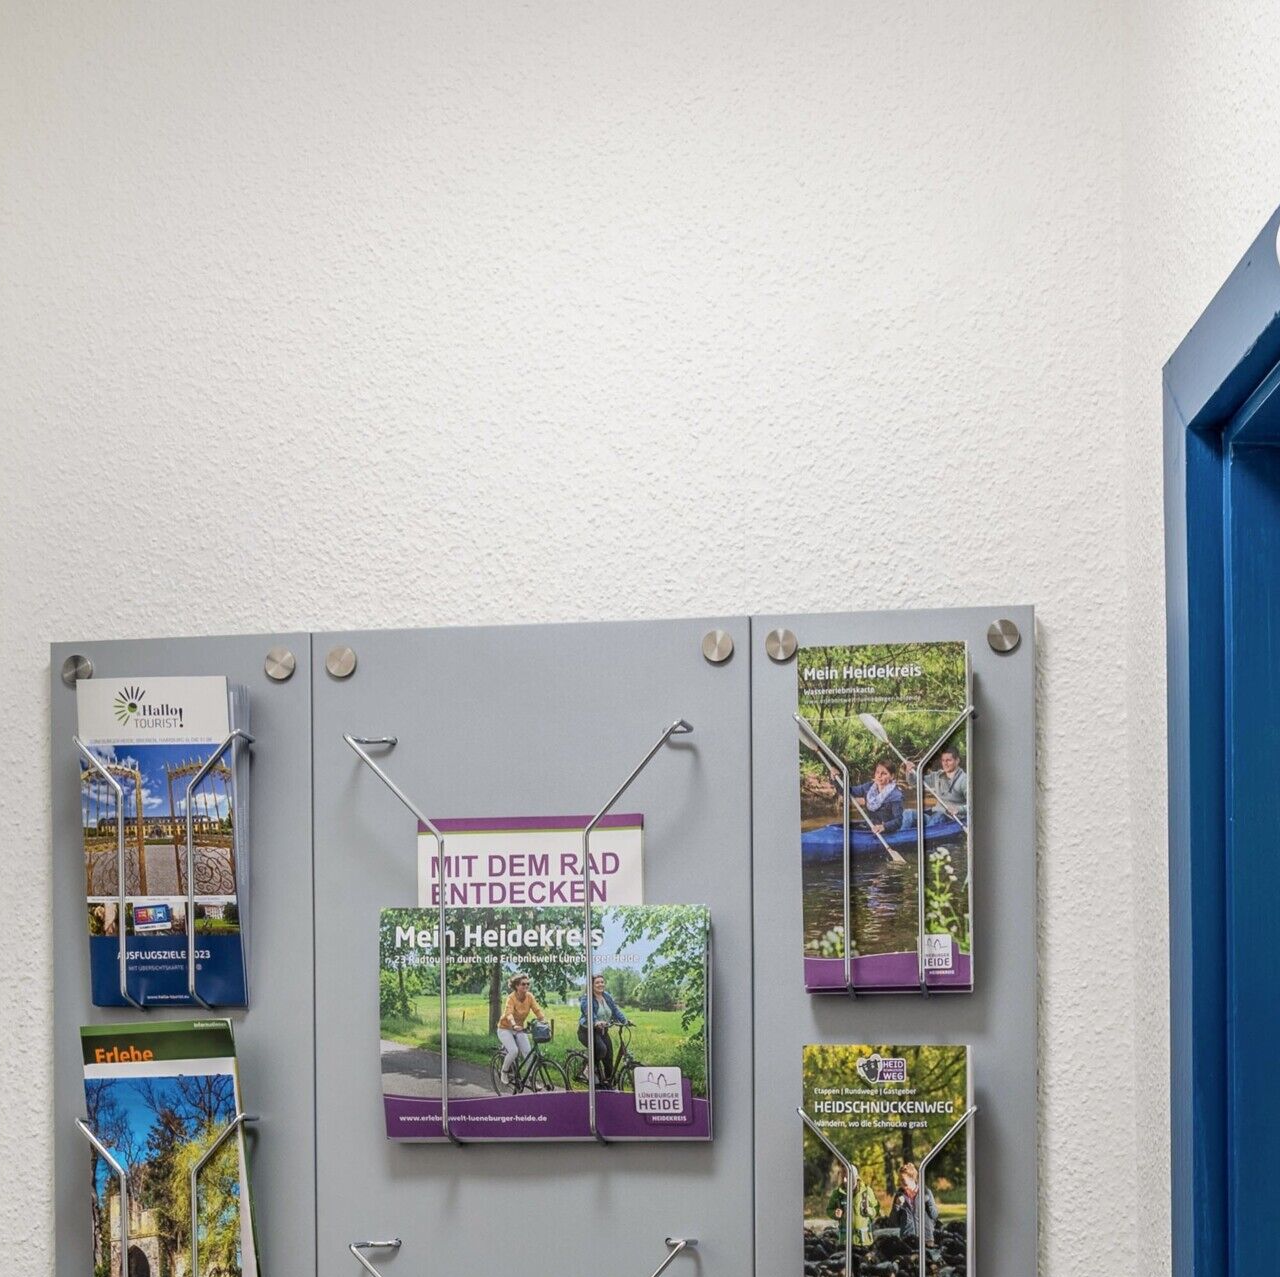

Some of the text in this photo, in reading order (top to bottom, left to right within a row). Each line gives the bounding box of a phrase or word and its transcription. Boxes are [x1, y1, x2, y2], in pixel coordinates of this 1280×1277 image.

[804, 664, 922, 680] Mein Heidekreis
[804, 686, 875, 695] Wassererlebniskarte
[141, 704, 178, 716] Hallo
[431, 852, 620, 878] MIT DEM RAD
[431, 880, 607, 905] ENTDECKEN
[395, 924, 603, 948] Mein Heidekreis
[190, 950, 211, 959] 023
[394, 953, 638, 965] 23 Radtouen durch die Erlebniswelt Lünebrger Heide
[883, 1060, 903, 1068] HEID
[883, 1072, 903, 1080] WEG
[638, 1099, 680, 1110] HEIDE
[814, 1101, 953, 1113] HEIDSCHNUCKENWEG
[814, 1120, 847, 1128] Wandern,
[909, 1120, 927, 1129] grast
